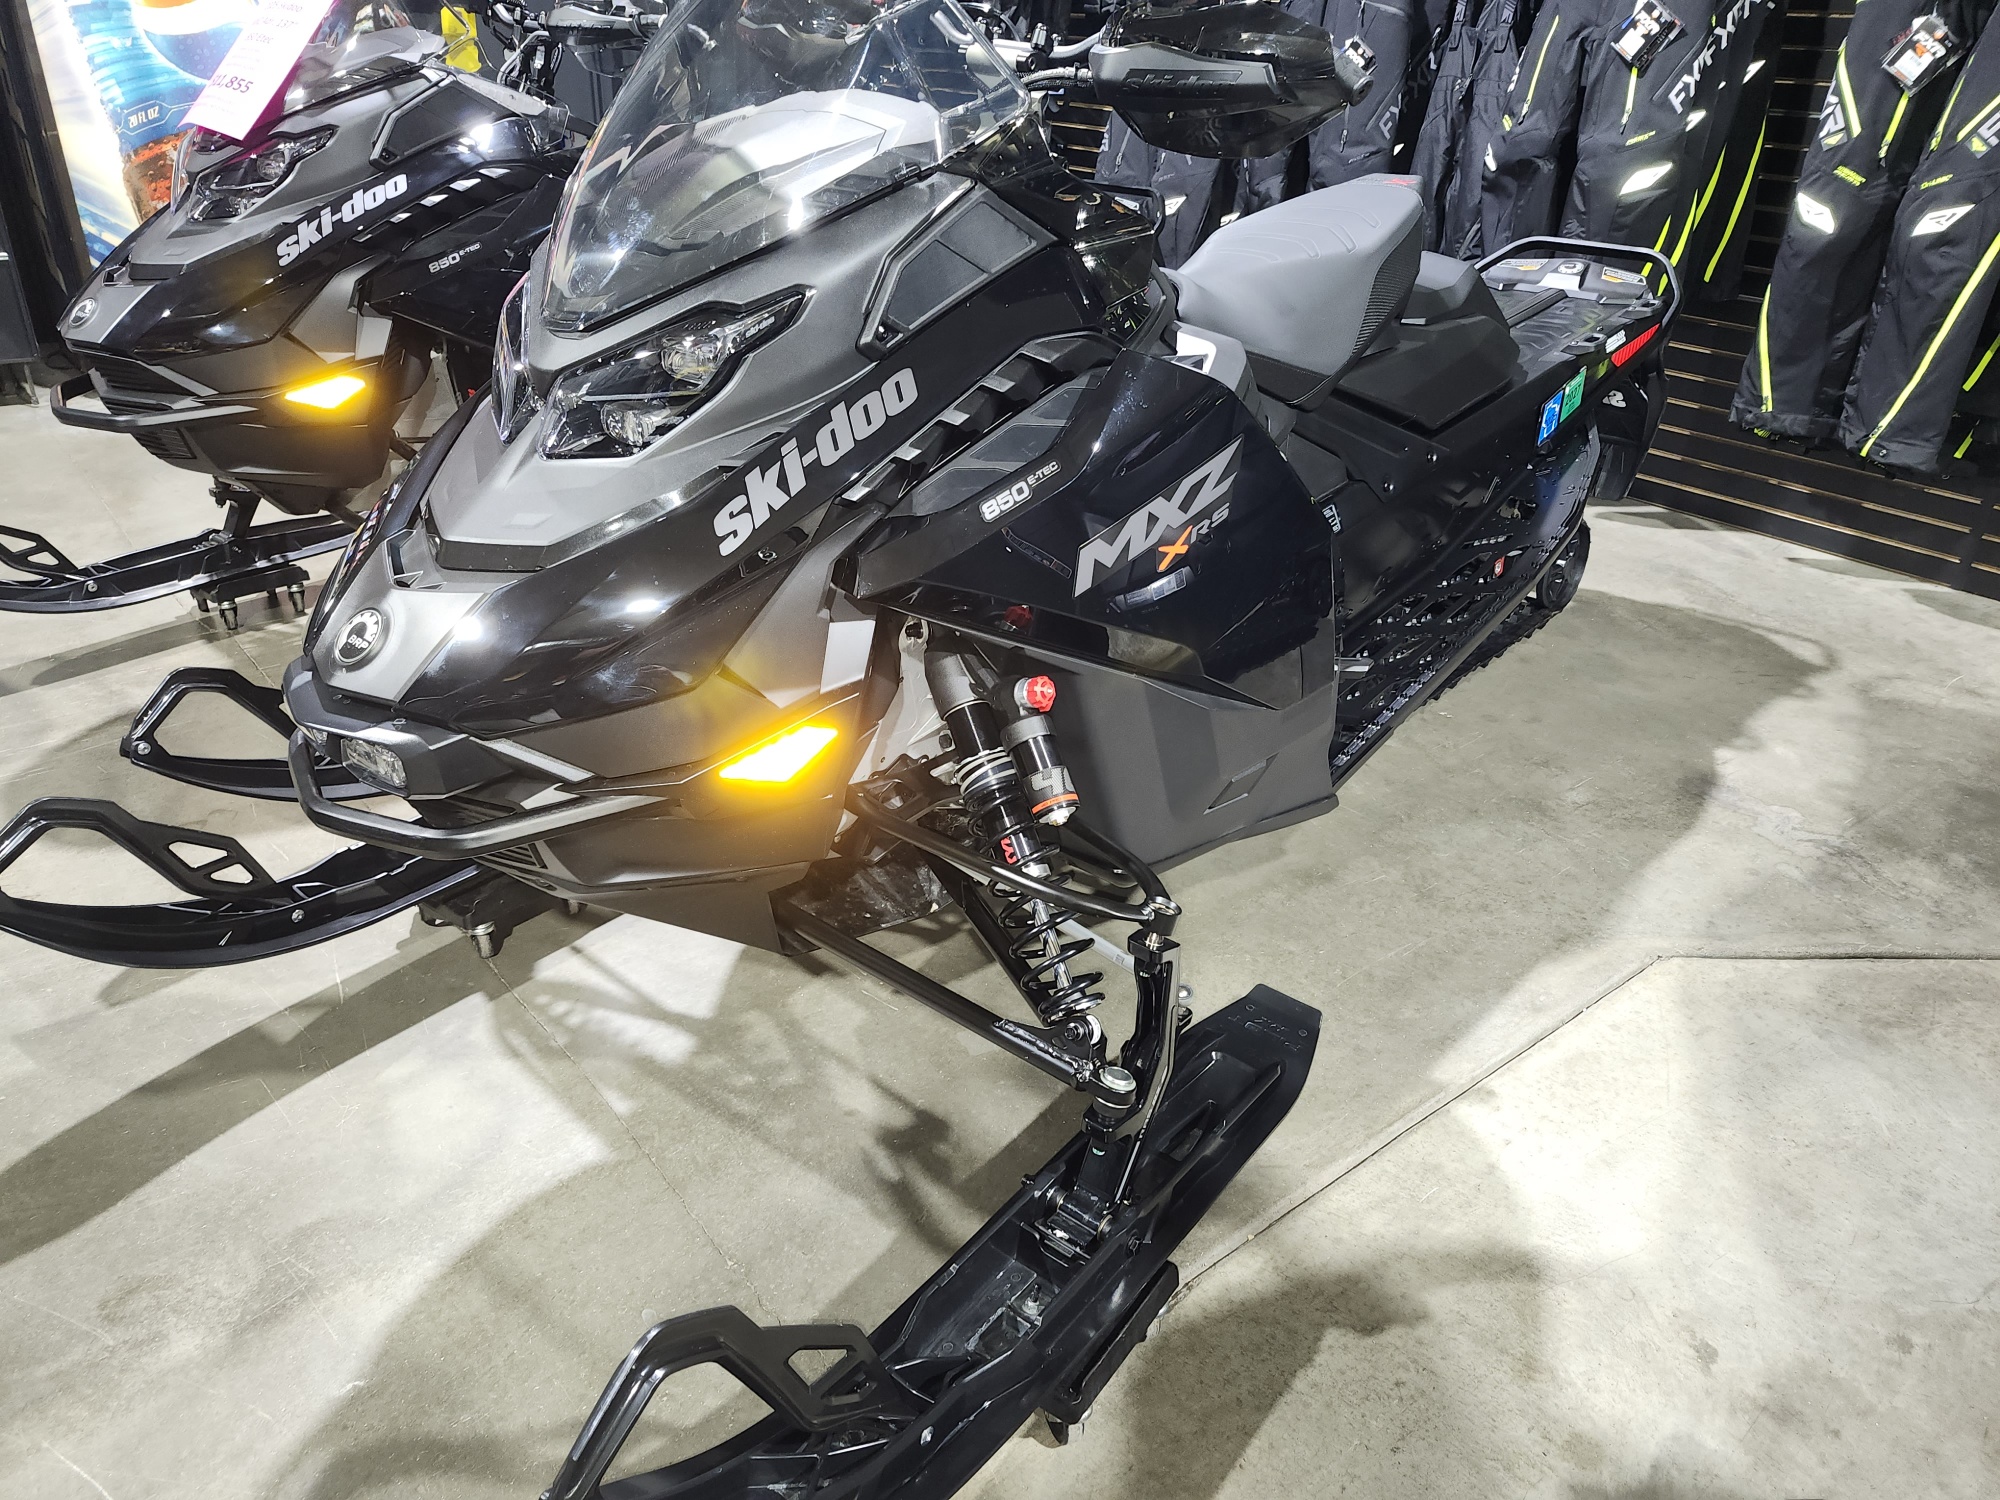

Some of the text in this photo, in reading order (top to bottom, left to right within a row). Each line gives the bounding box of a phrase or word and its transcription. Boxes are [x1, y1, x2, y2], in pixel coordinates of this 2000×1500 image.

[128, 106, 160, 128] 20 FL OZ
[276, 173, 408, 267] ski-doo
[428, 252, 461, 273] 850
[713, 367, 919, 557] ski-doo
[981, 461, 1059, 521] 850 E-TEC
[1074, 436, 1243, 598] MXZ
[347, 634, 370, 650] BRP
